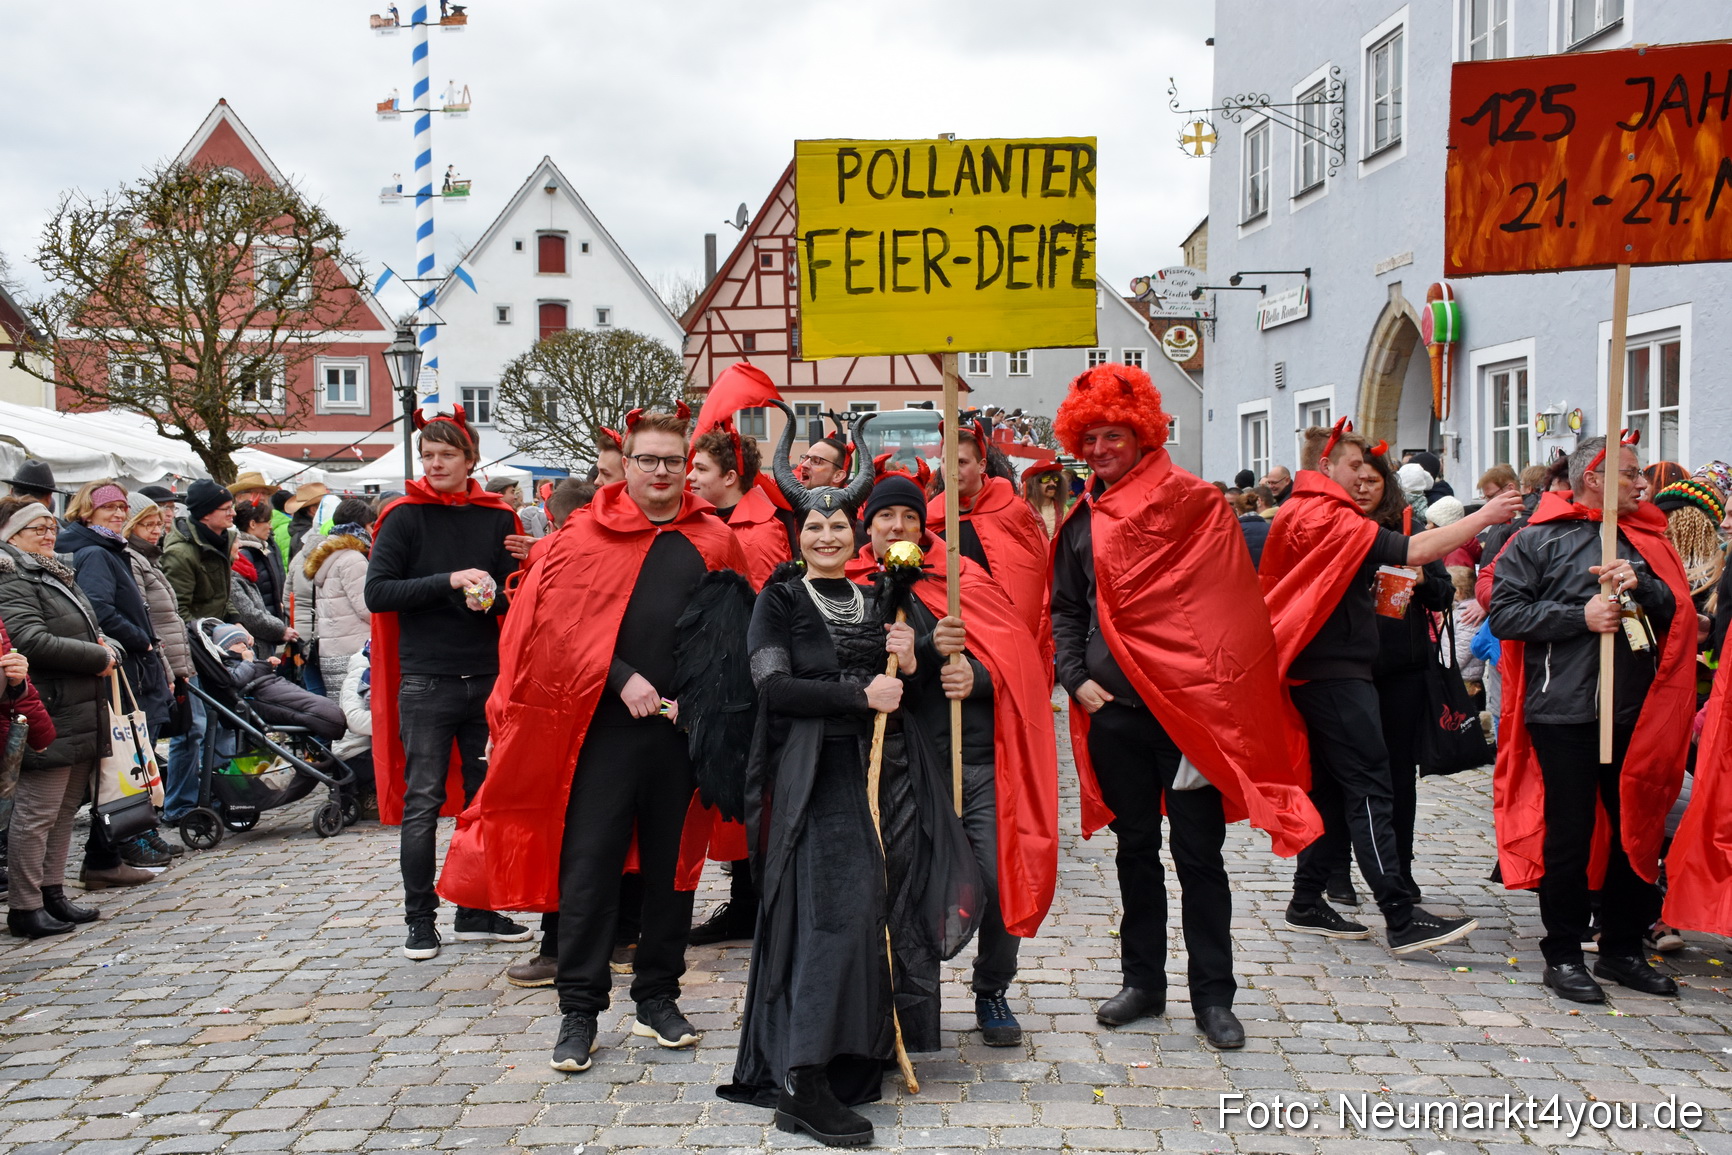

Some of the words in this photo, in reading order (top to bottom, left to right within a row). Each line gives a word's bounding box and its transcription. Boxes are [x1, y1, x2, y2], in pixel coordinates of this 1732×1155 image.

[1460, 83, 1577, 147] 125
[1616, 68, 1732, 132] JAH
[836, 143, 1097, 204] POLLANTER
[804, 219, 1097, 302] FEIER-DEIFE
[1164, 268, 1196, 277] Pizzeria
[1171, 279, 1188, 287] Café
[1163, 288, 1193, 298] Eisdiel
[1264, 307, 1280, 325] Bella
[1280, 304, 1299, 320] Roma
